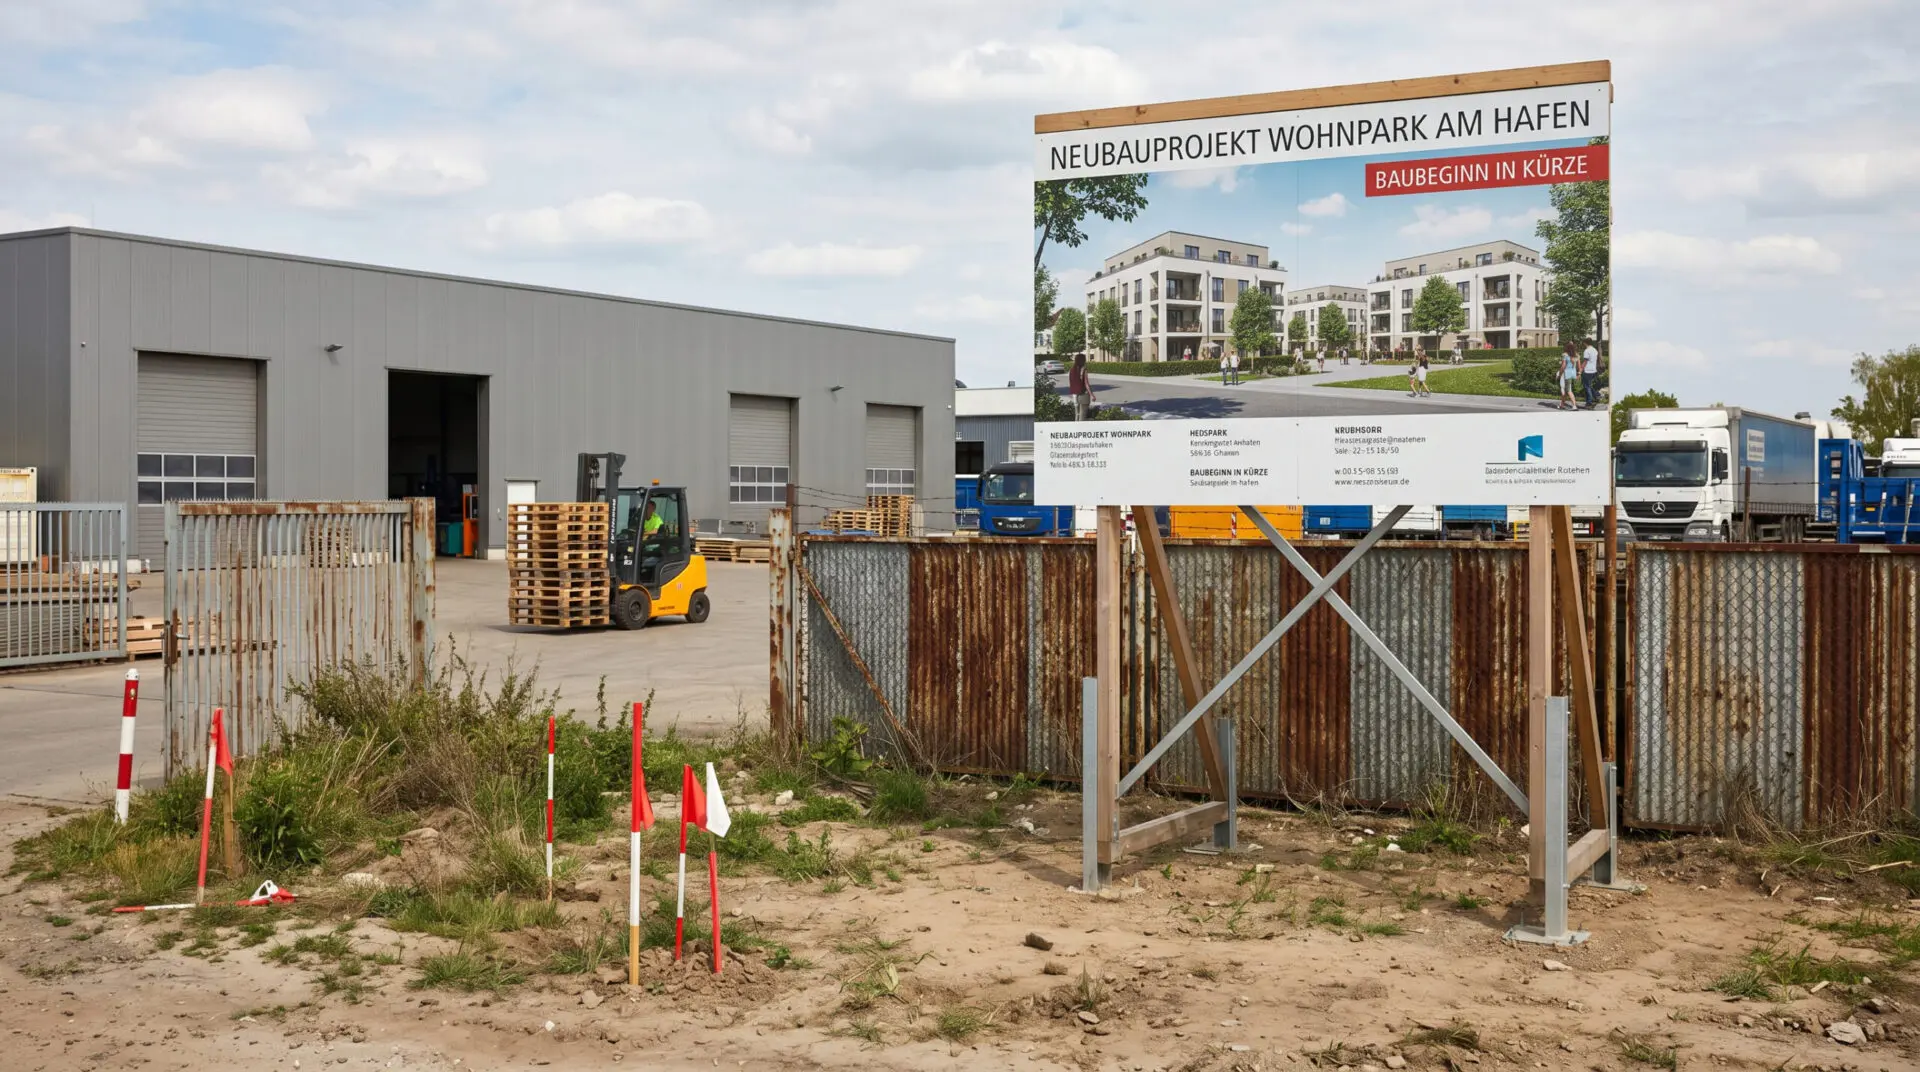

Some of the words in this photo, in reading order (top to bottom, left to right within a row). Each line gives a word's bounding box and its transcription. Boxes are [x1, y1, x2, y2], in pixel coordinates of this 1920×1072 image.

[1050, 128, 1260, 170] NEUBAUPROJEKT
[1268, 113, 1428, 151] WOHNPARK
[1435, 108, 1483, 139] AM
[1494, 99, 1591, 134] HAFEN
[1375, 163, 1491, 189] BAUBEGINN
[1495, 161, 1517, 180] IN
[1523, 154, 1589, 179] KÜRZE
[1050, 431, 1109, 439] NEUBAUPROJEKT
[1110, 430, 1152, 438] WOHNPARK
[1190, 429, 1228, 437] HEDSPARK
[1190, 468, 1232, 476] BAUBEGINN
[1233, 468, 1242, 476] IN
[1243, 467, 1269, 476] KÜRZE
